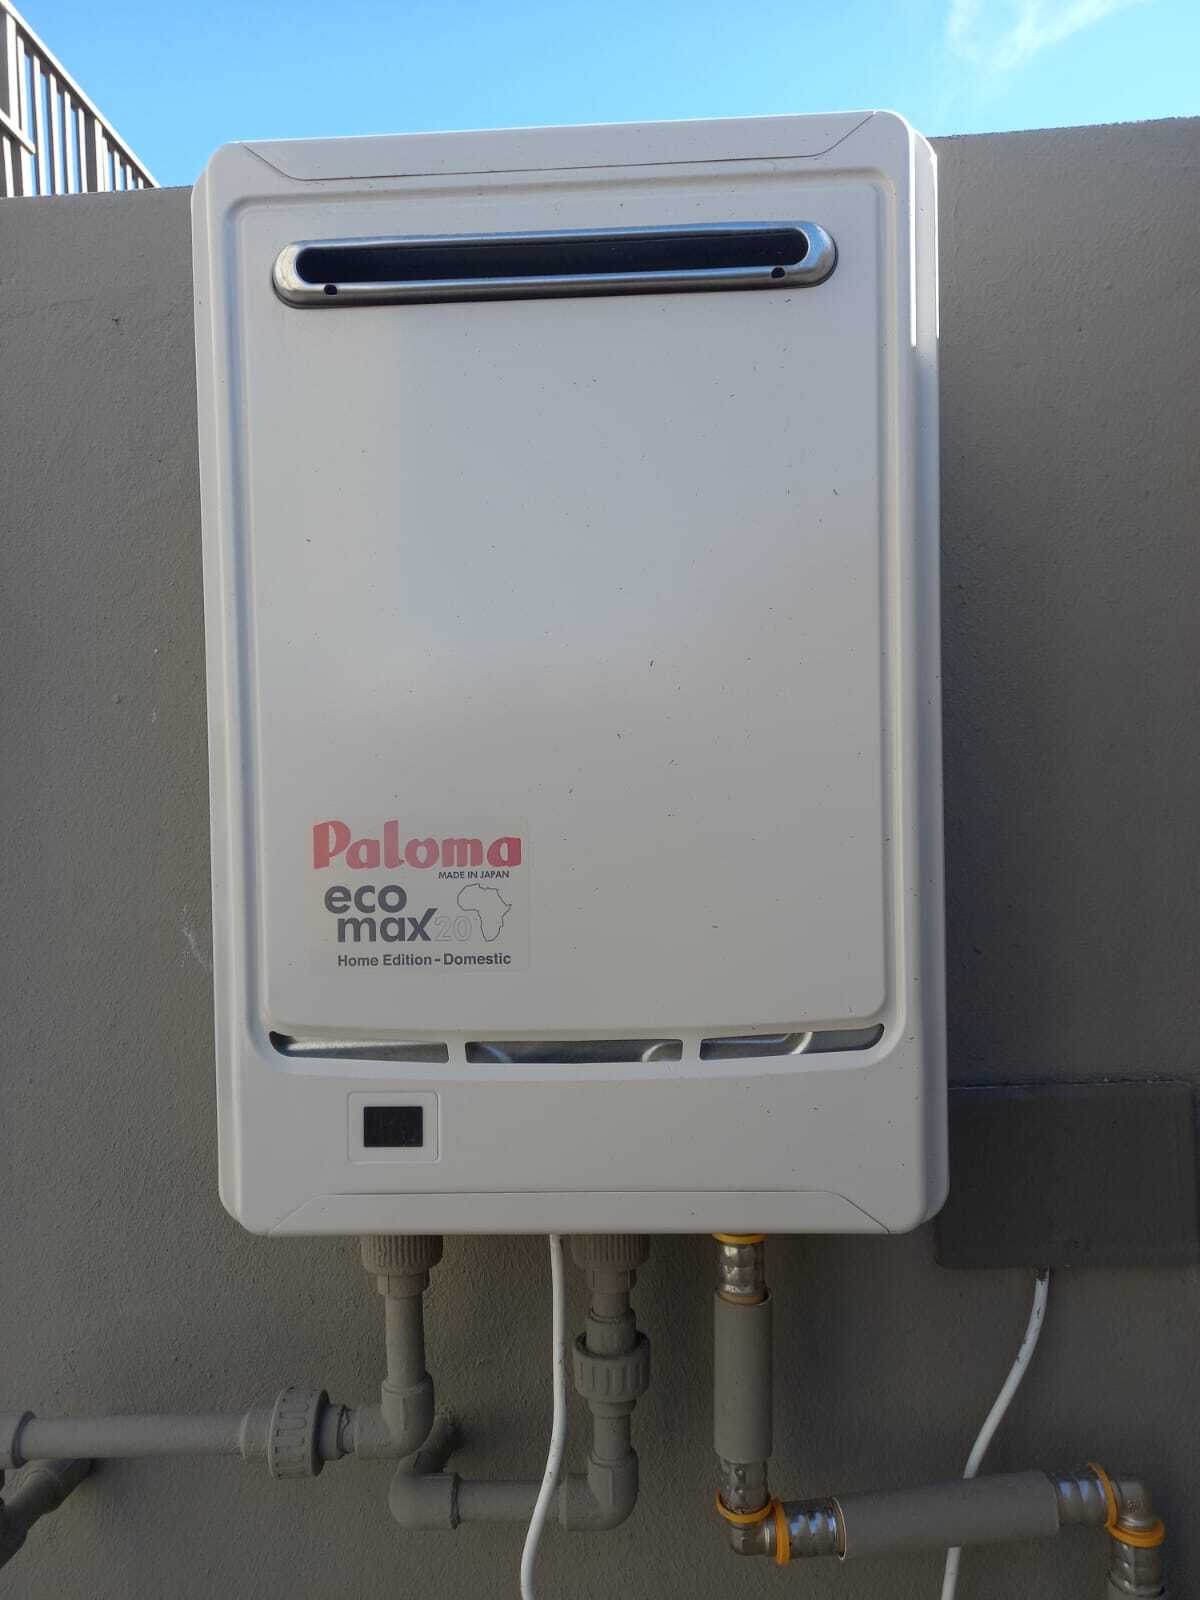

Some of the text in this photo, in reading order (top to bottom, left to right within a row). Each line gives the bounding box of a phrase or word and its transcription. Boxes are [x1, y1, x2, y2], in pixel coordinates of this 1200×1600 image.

[312, 820, 522, 870] Paloma
[438, 869, 510, 880] MADE IN JAPAN
[324, 885, 408, 914] eco
[337, 954, 379, 967] Home
